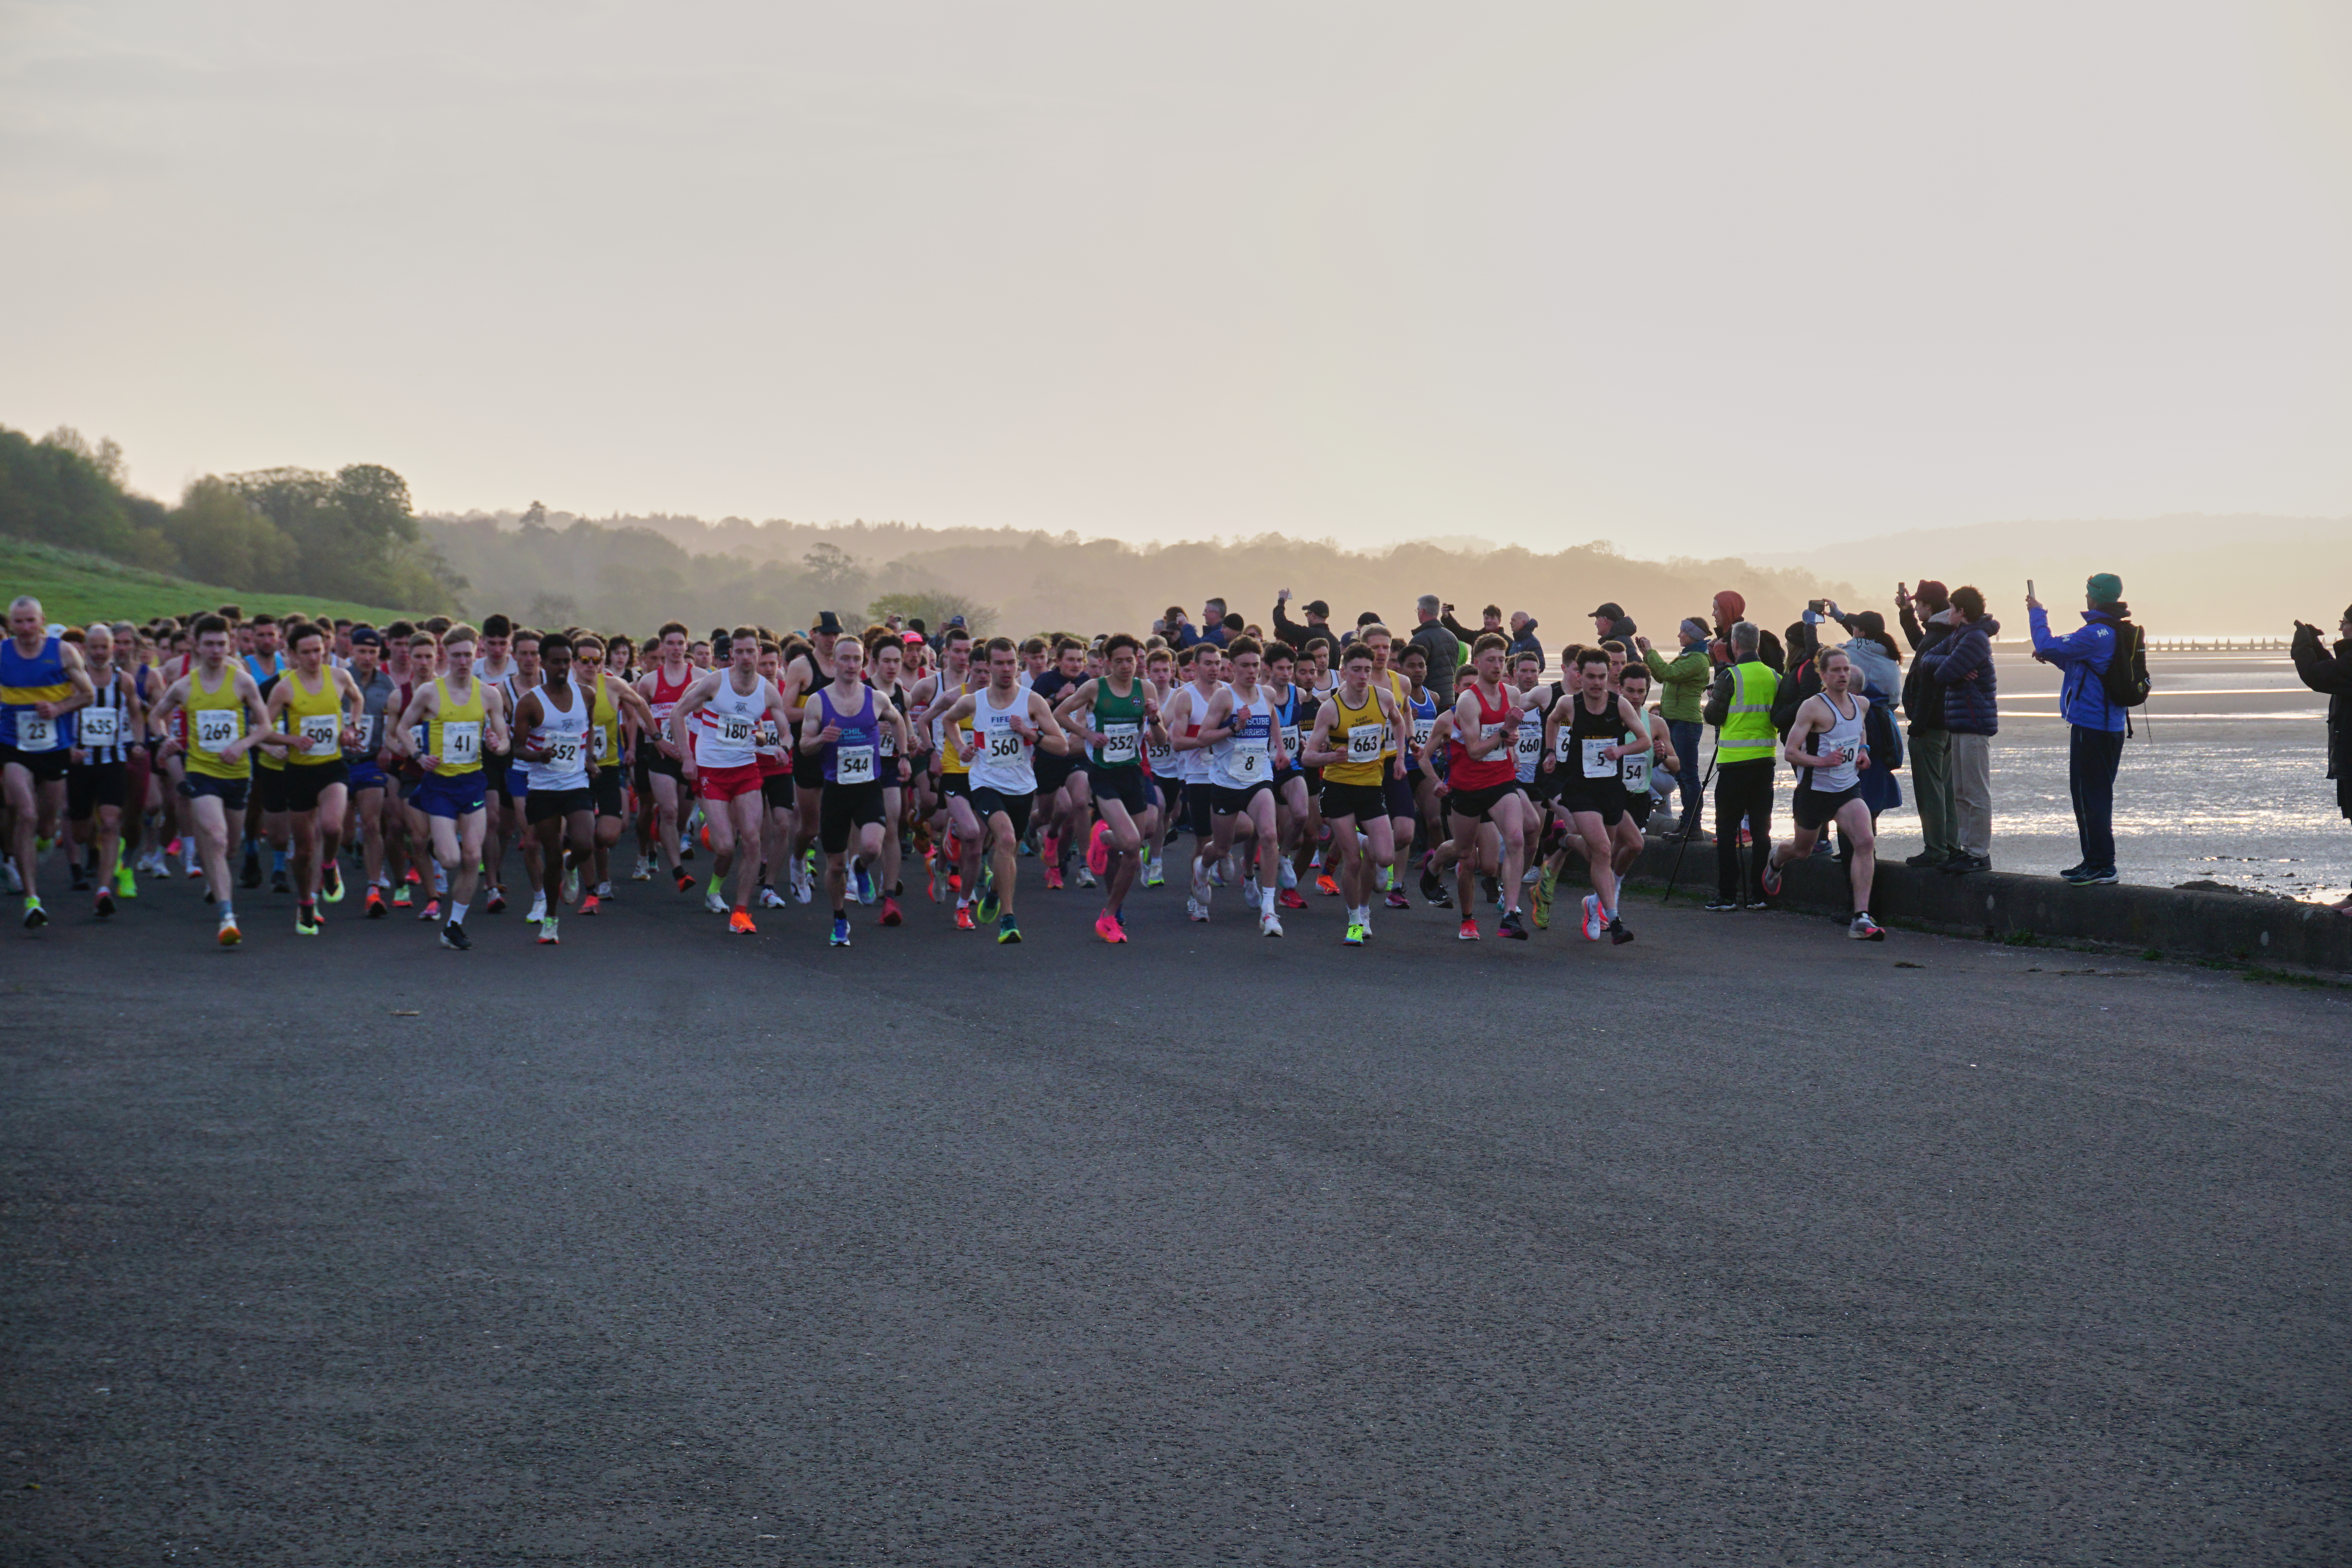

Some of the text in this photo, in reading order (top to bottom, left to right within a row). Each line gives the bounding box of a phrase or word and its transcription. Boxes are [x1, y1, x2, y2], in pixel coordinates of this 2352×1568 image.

[28, 723, 46, 739] 23
[87, 720, 111, 734] 635
[204, 724, 230, 740] 269
[725, 724, 747, 739] 180
[455, 736, 469, 751] 41
[992, 738, 1018, 756] 560
[1109, 735, 1133, 751] 552
[1150, 744, 1170, 757] 559
[1354, 736, 1377, 752] 663
[1519, 739, 1539, 753] 660
[843, 758, 868, 773] 544
[1245, 756, 1254, 771] 8
[1597, 751, 1605, 766] 5
[1626, 765, 1641, 780] 54
